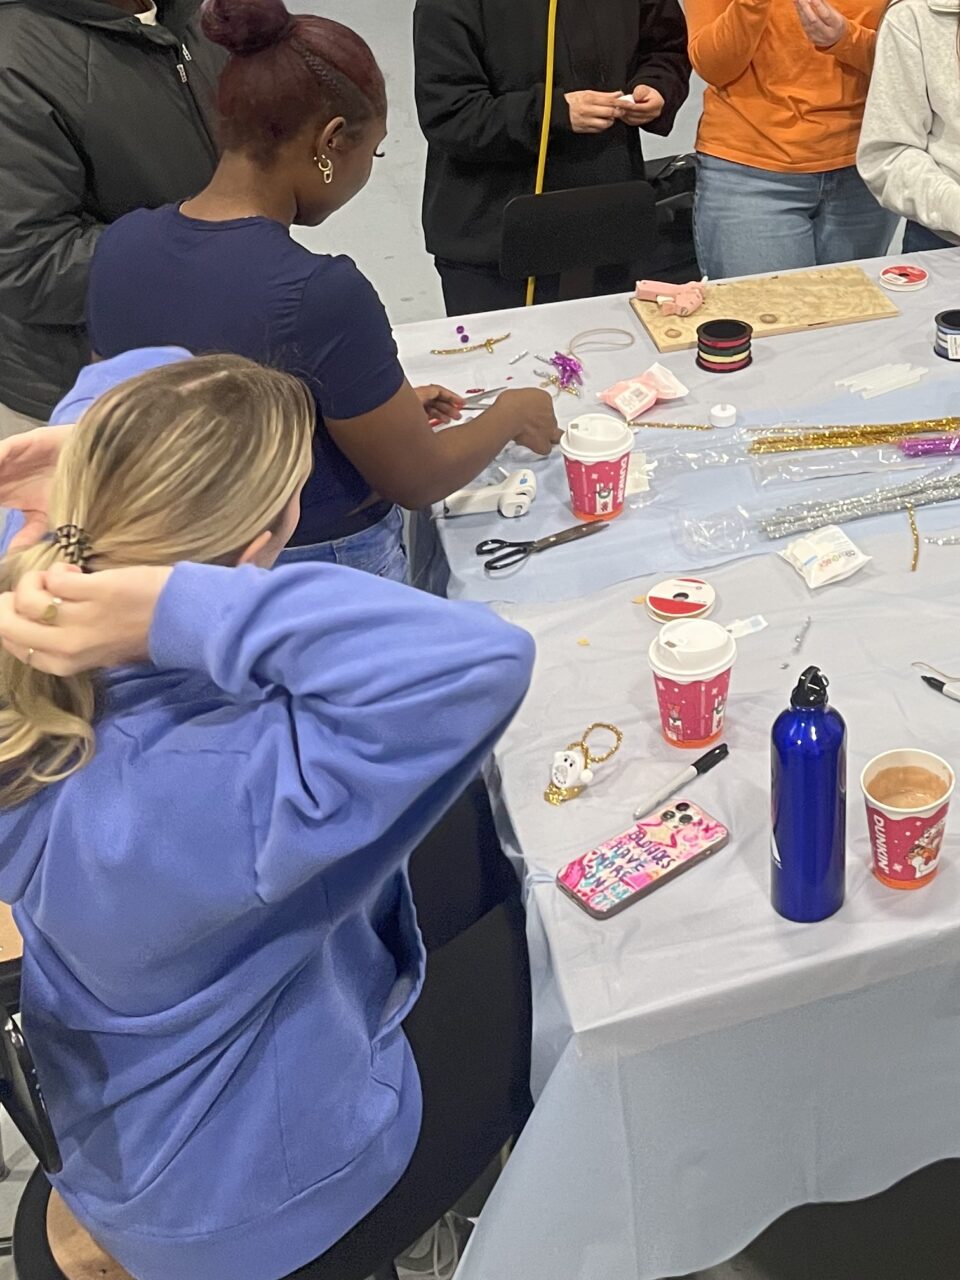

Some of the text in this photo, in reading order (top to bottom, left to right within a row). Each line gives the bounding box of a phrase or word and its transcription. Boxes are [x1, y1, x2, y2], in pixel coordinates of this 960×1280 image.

[610, 841, 645, 872] HAVE
[628, 829, 677, 869] BLONDES
[873, 814, 890, 874] DUNKIN'
[594, 852, 633, 882] MORE
